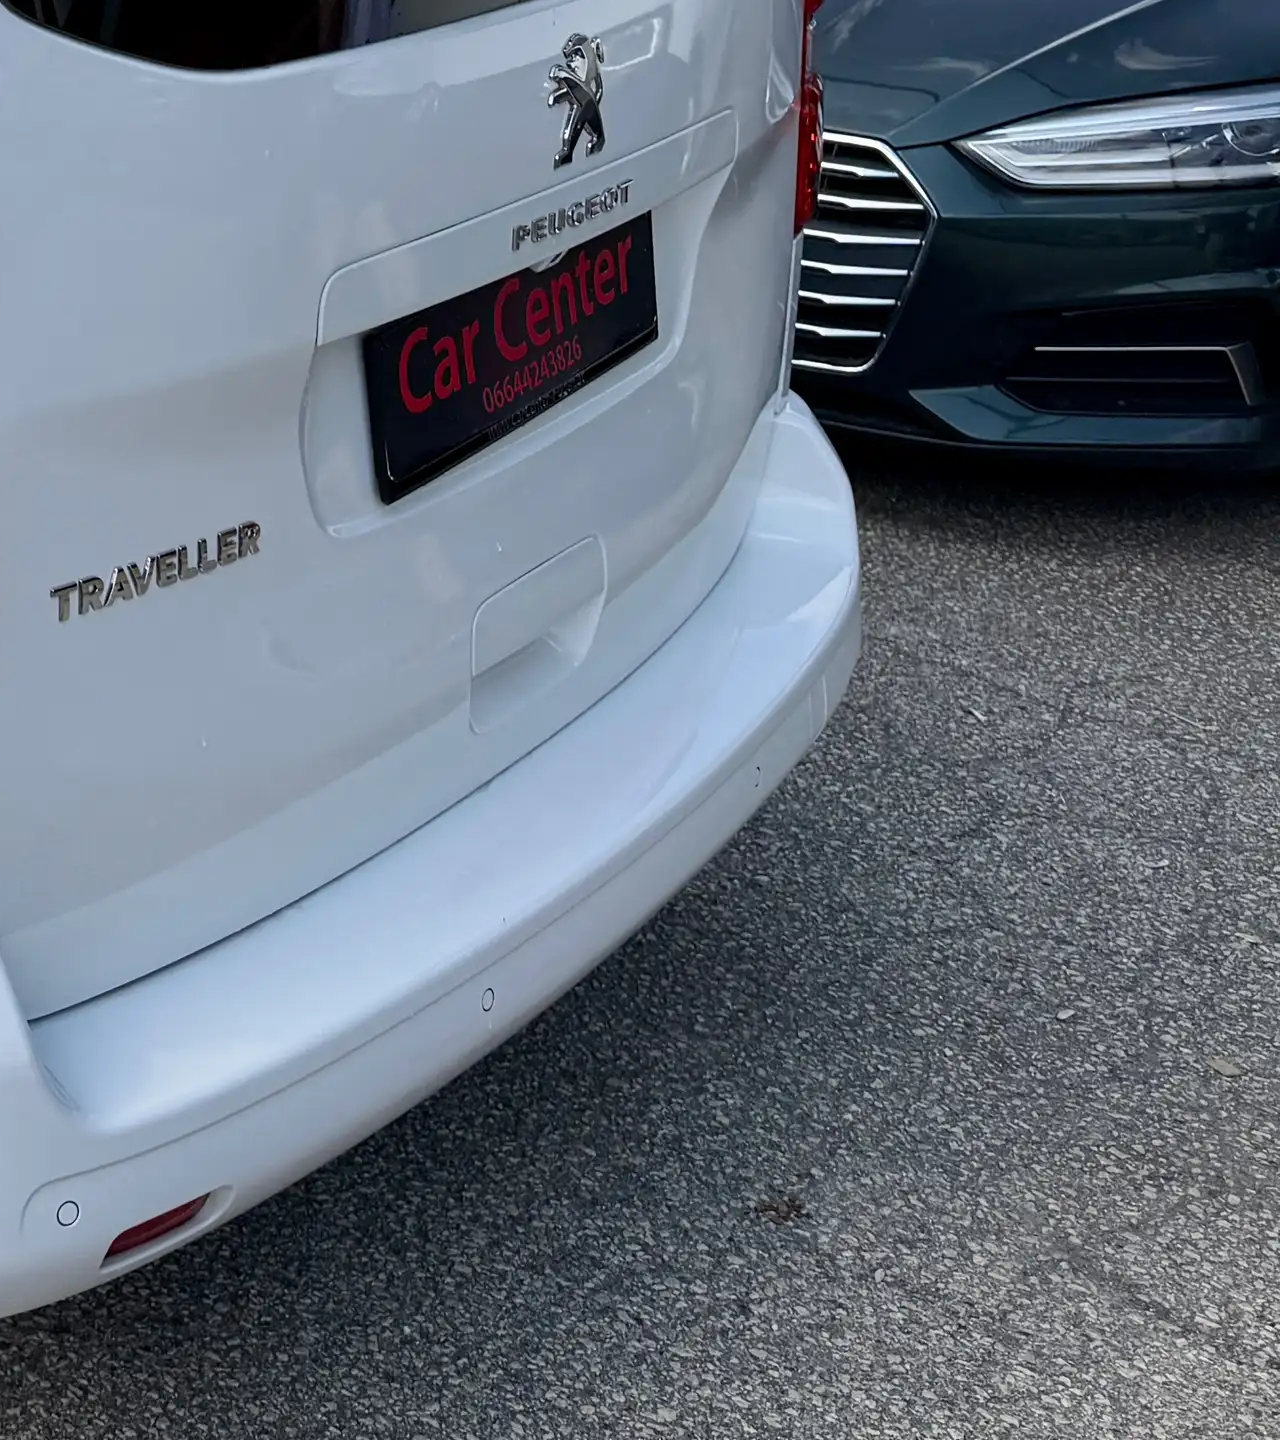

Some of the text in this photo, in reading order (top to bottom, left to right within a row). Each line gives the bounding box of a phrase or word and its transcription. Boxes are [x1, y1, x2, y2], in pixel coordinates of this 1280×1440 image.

[511, 179, 634, 252] PEUGEOT
[397, 321, 479, 414] Car
[494, 234, 632, 361] Center
[482, 335, 583, 414] 06644243826
[49, 520, 261, 623] TRAVELLER
